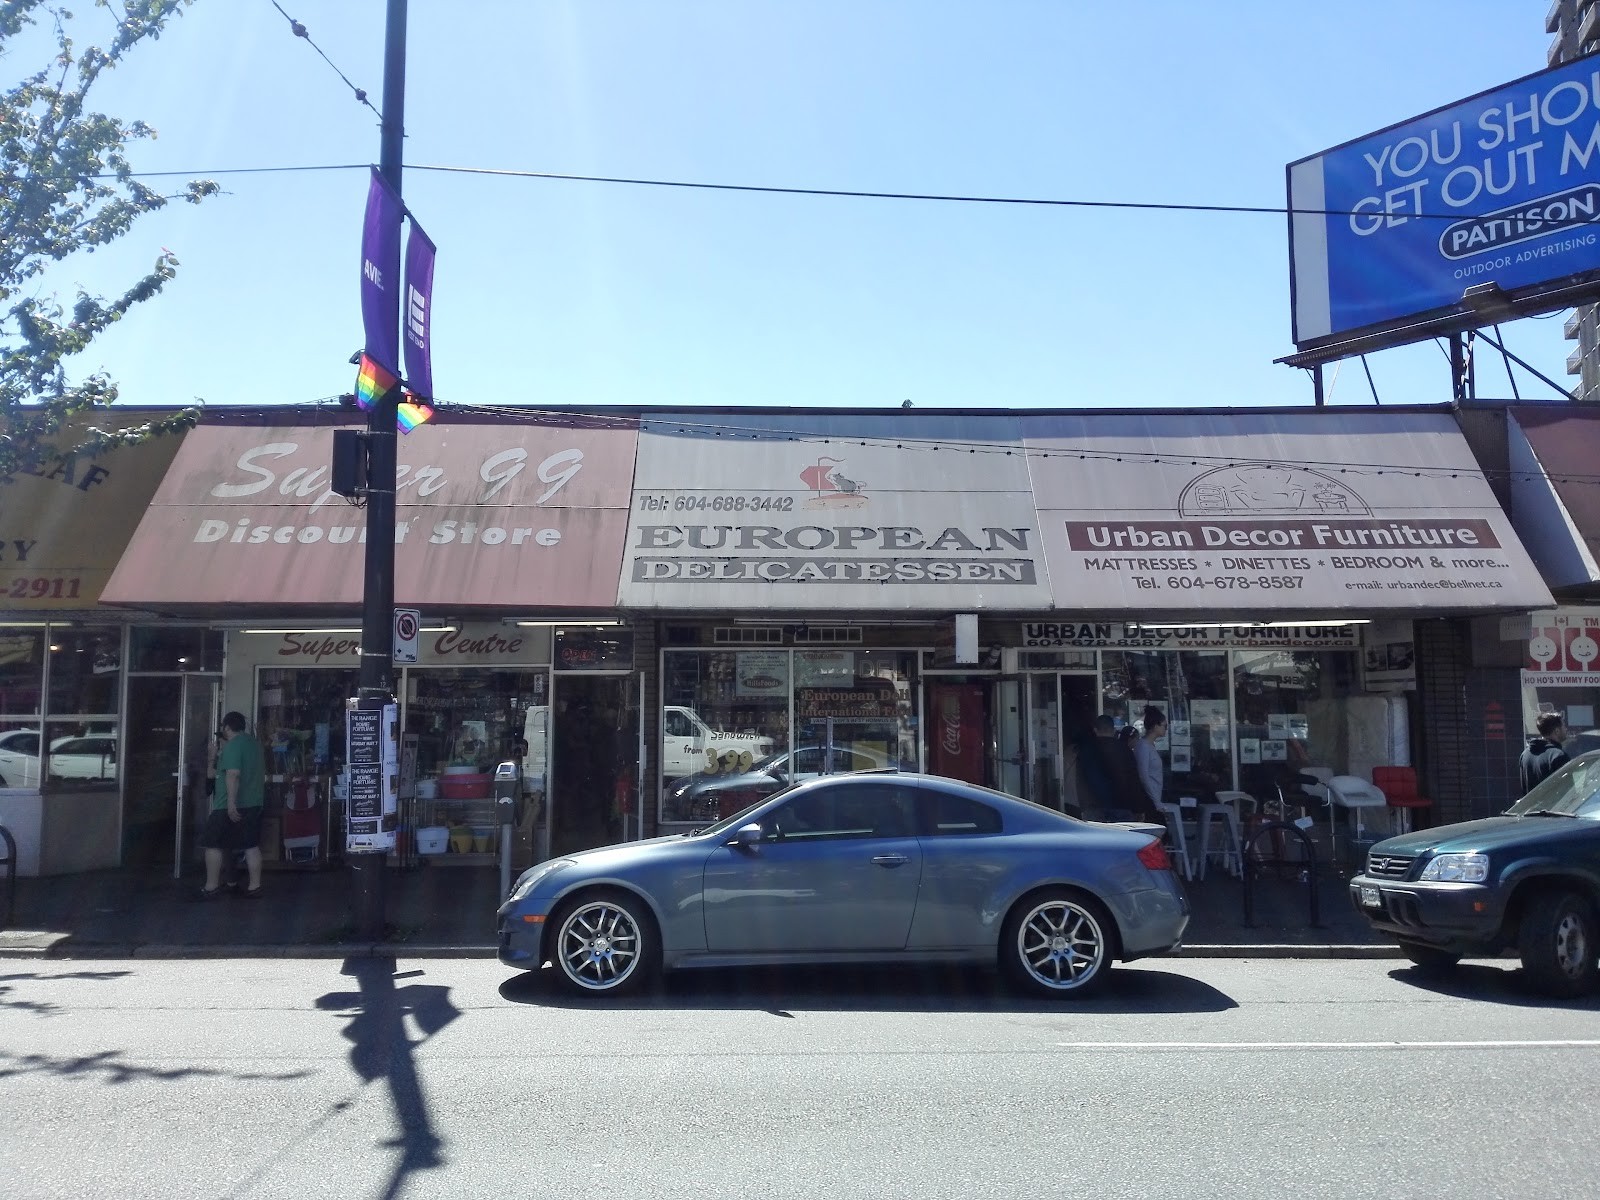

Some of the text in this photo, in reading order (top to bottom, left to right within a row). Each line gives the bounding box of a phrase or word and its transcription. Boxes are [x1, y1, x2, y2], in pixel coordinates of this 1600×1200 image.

[1363, 120, 1462, 187] YOU
[1350, 178, 1429, 236] GET
[1441, 140, 1544, 207] OUT
[1452, 192, 1594, 252] PATTISON
[1454, 234, 1597, 280] OUTDOOR ADVERTISING
[477, 447, 584, 505] 99
[639, 494, 794, 512] Tel: 604-688-3442
[193, 518, 562, 546] Discout Store
[635, 525, 1031, 552] EUROPEAN
[1086, 523, 1479, 548] Urban Decor Furniture
[642, 560, 1025, 582] DELICATESSEN
[1084, 555, 1510, 571] MATTRESSES DINETTES BEDROOM & more...
[1131, 575, 1304, 590] Tel. 604-678-8587
[1345, 578, 1503, 591] e-mail: urbandec@bellnet.ca
[278, 617, 523, 663] Super Centre
[1027, 623, 1354, 639] URBAN DECOR FURNITURE
[1027, 637, 1354, 648] 604-678-8587 www.urbandecor.ca
[1556, 676, 1582, 684] YUMMY
[1584, 676, 1600, 684] FOO
[803, 689, 876, 704] European
[683, 744, 703, 755] from
